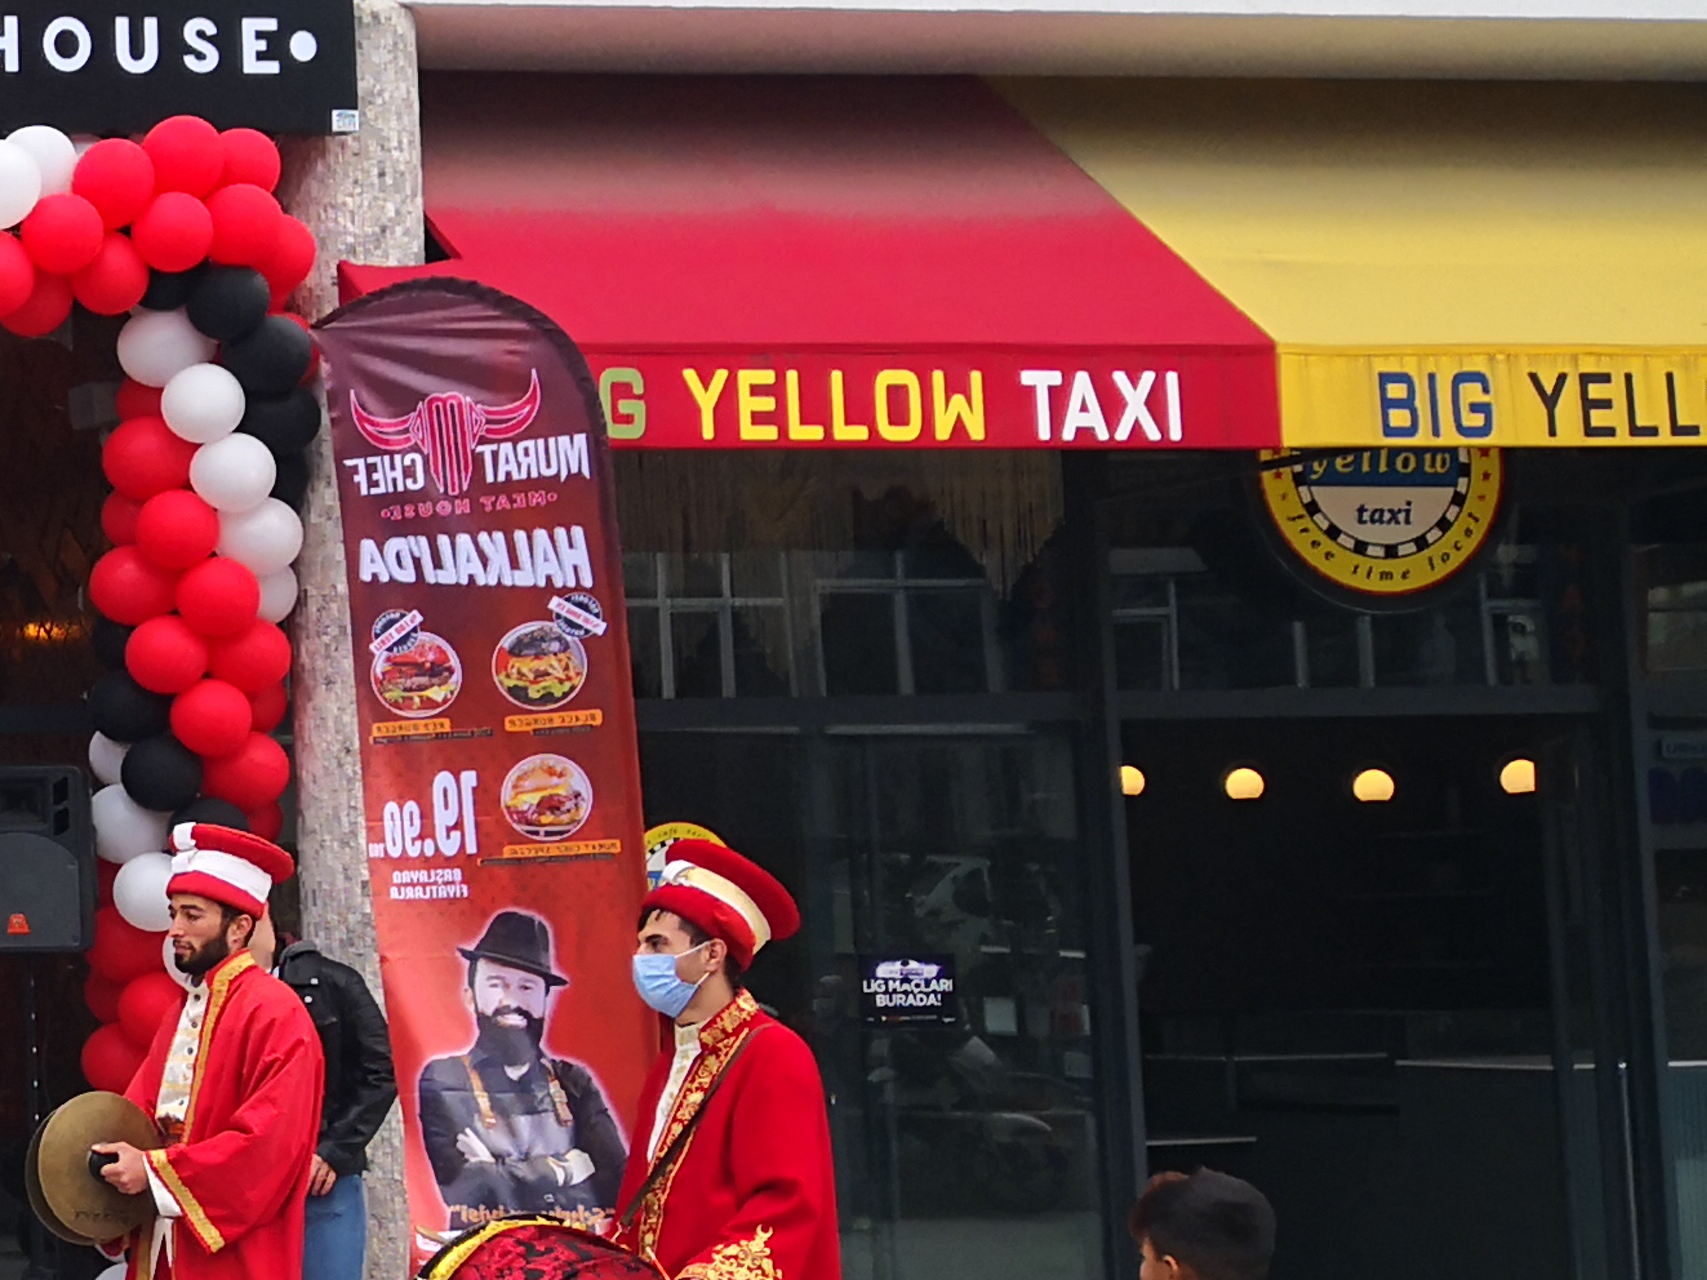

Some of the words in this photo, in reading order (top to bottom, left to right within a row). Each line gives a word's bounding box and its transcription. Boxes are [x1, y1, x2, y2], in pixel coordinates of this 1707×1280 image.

[682, 368, 987, 441] YELLOW
[1020, 369, 1184, 442] TAXI
[1377, 371, 1494, 439] BIG
[1527, 371, 1707, 438] YELL
[1356, 500, 1413, 525] taxi
[875, 993, 943, 1007] BURADA!
